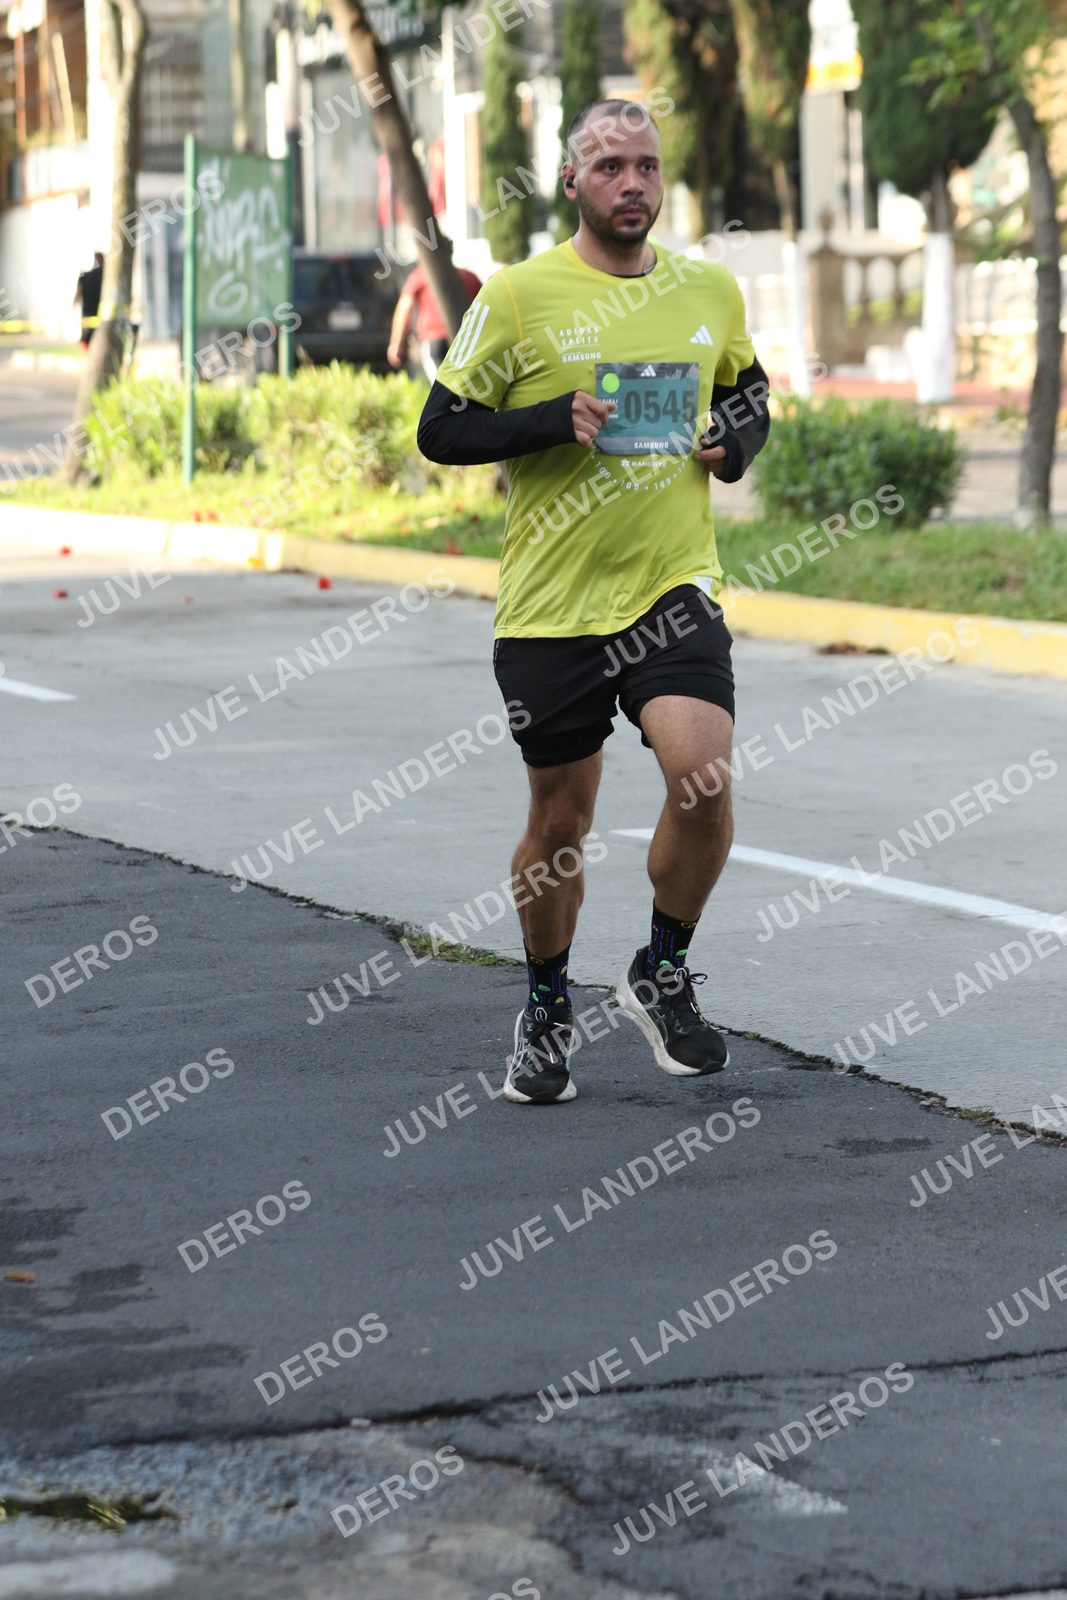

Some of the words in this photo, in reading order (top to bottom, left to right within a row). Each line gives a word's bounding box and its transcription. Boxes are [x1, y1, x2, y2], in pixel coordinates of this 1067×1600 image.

[562, 352, 602, 363] SAMSUNG
[624, 389, 696, 425] 0545
[633, 441, 669, 449] SAMSUNG
